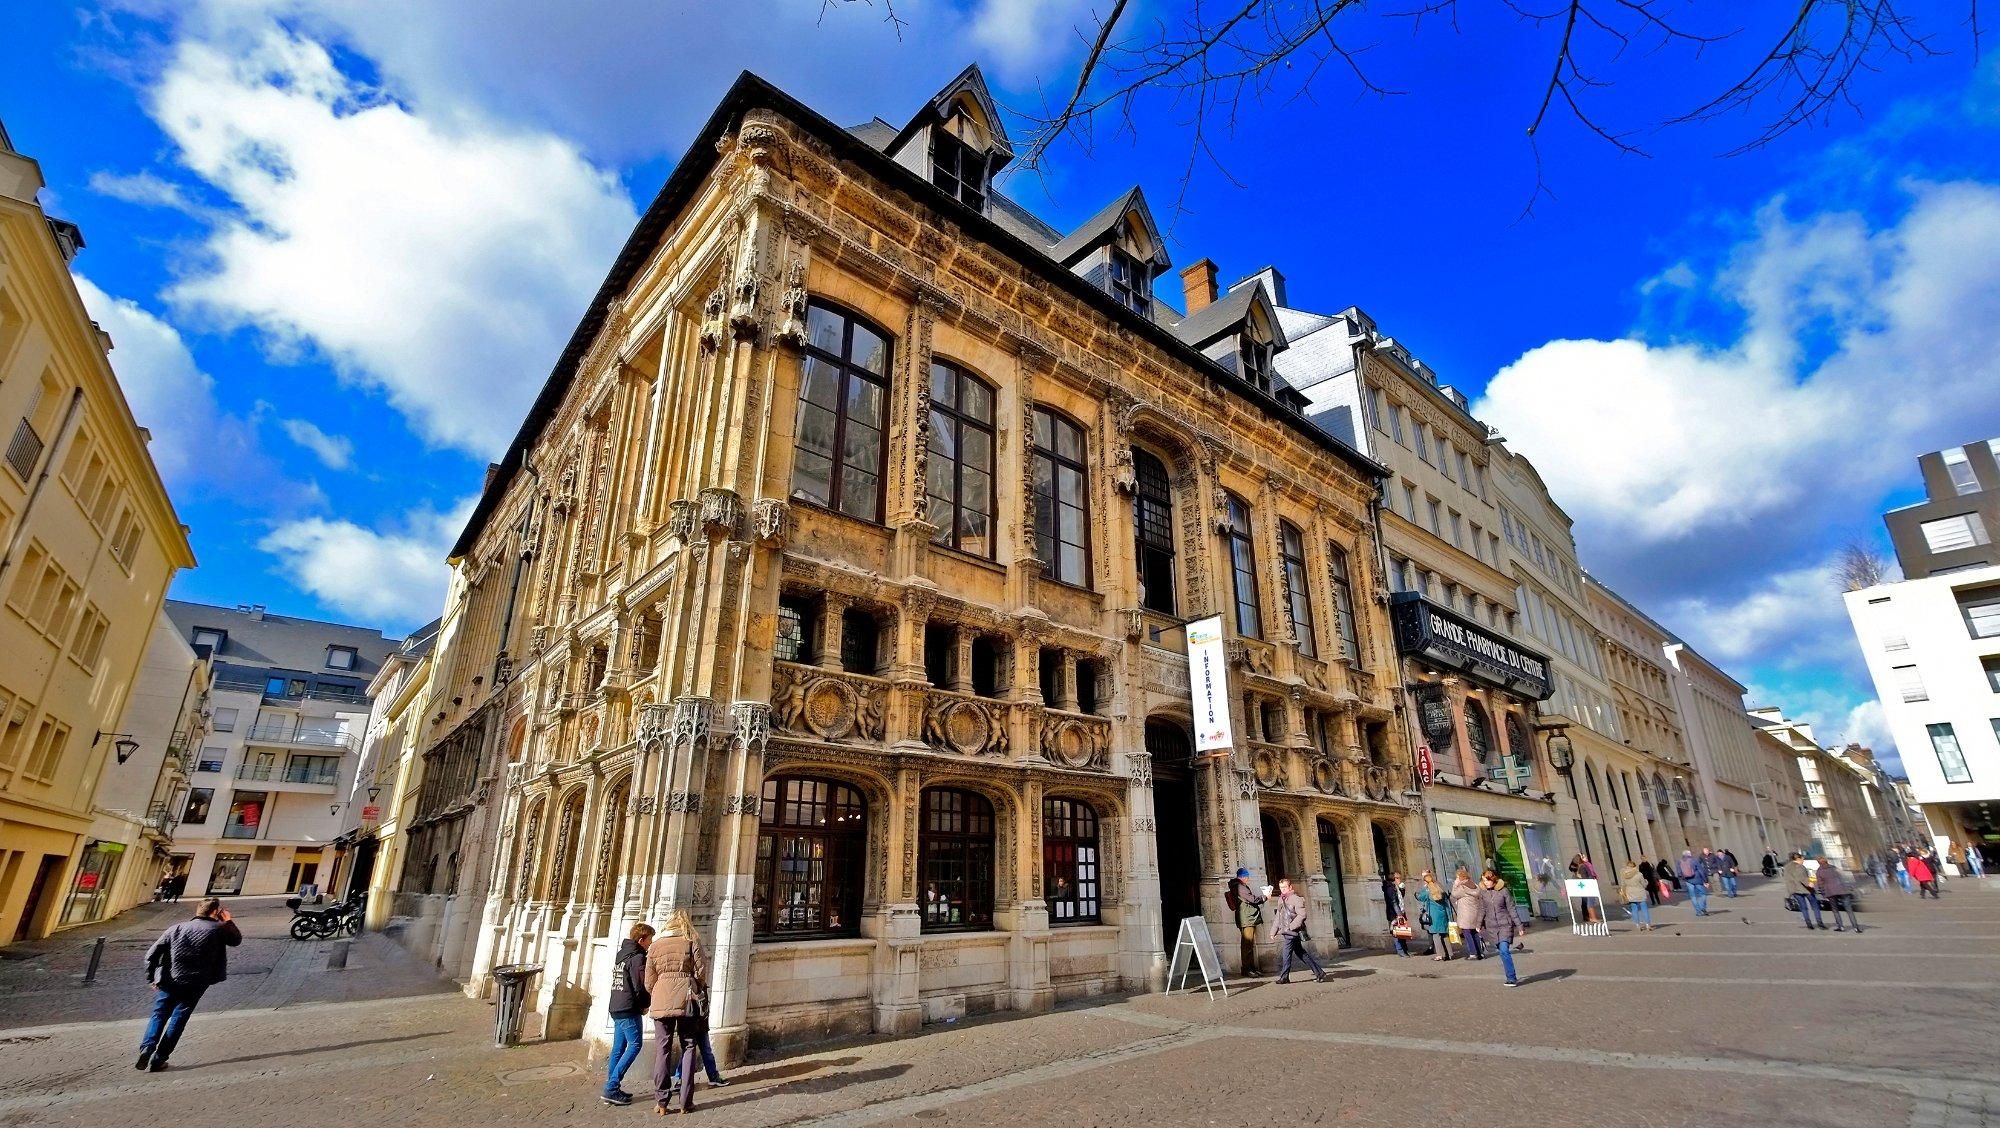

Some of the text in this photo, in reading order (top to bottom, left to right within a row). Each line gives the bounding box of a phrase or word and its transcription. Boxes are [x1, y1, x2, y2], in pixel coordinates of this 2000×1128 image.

[1430, 613, 1467, 647] GRANDE
[1507, 648, 1521, 669] DU
[1519, 654, 1546, 681] CENTRE
[1203, 649, 1215, 724] INFORMATION
[1419, 748, 1430, 783] TABAC
